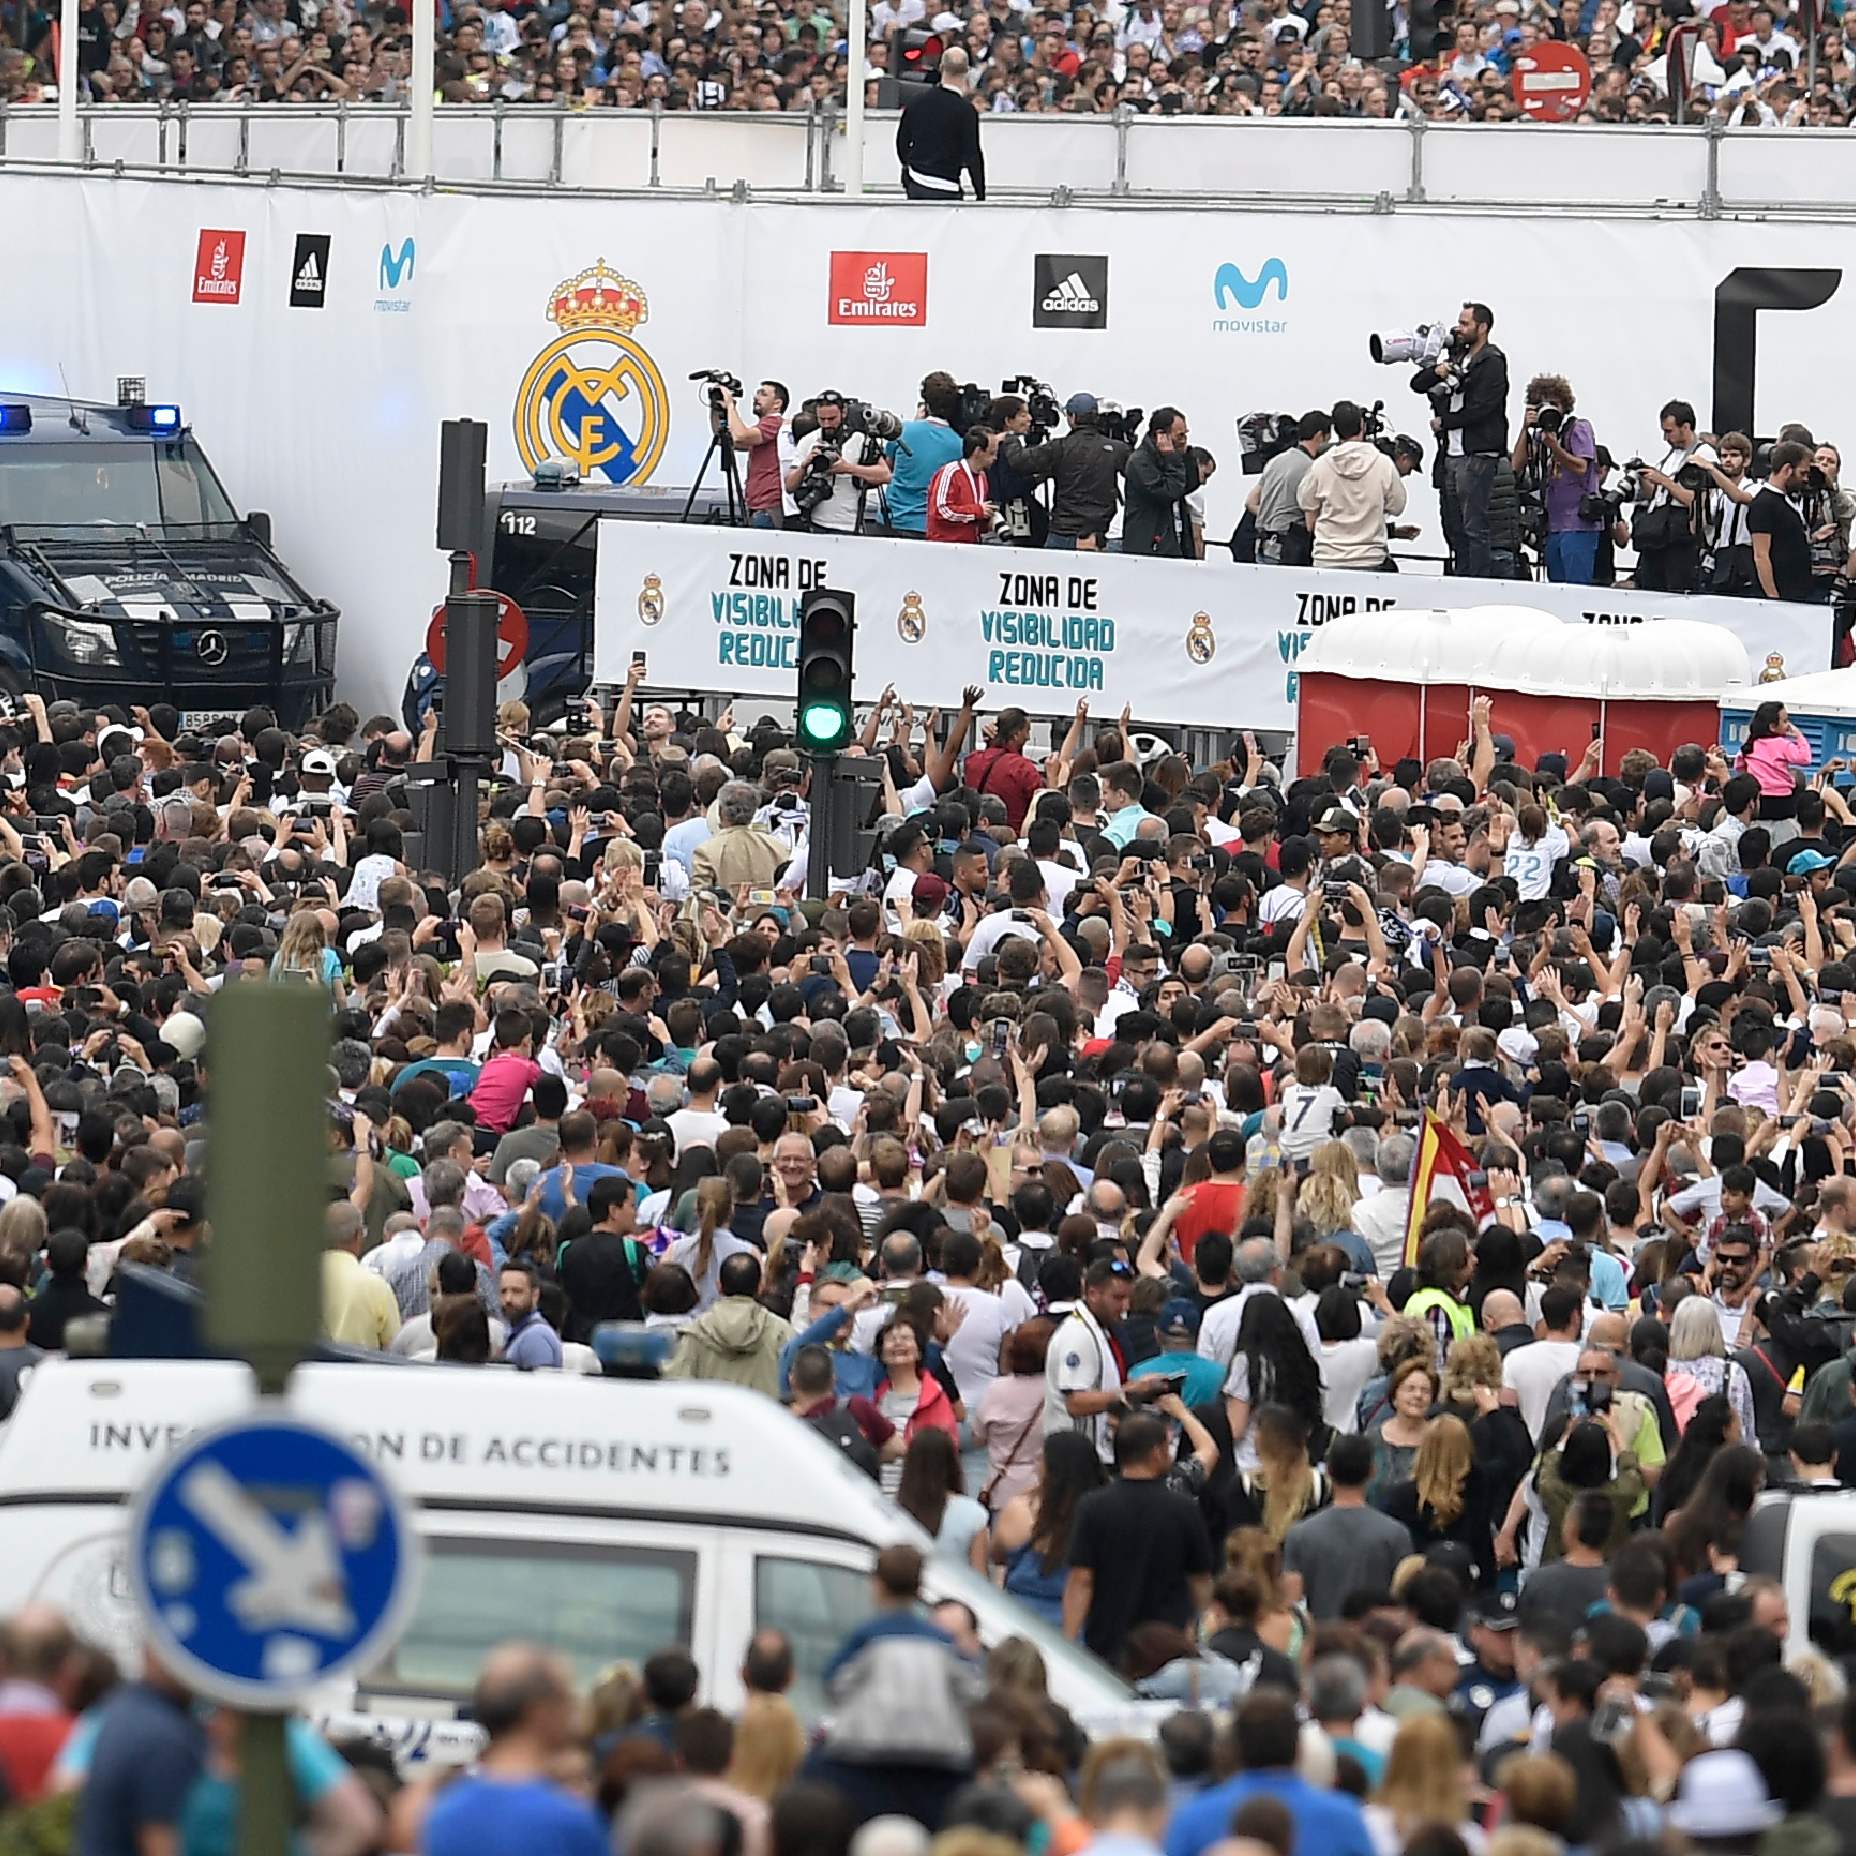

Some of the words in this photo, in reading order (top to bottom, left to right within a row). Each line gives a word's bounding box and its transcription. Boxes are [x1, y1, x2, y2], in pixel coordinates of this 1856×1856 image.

[838, 298, 917, 319] Emirates
[1041, 297, 1099, 313] adidas
[1212, 319, 1288, 334] movistar
[506, 515, 536, 535] 112
[729, 553, 790, 589] ZONA
[797, 557, 829, 591] DE
[711, 591, 802, 630] VISIBILI
[999, 571, 1059, 608] ZONA
[1067, 576, 1098, 612] DE
[718, 630, 800, 670] REDUC
[981, 610, 1115, 653] VISIBILIDAD
[987, 649, 1105, 692] REDUCIDA
[1507, 854, 1541, 881] 22
[1293, 1096, 1317, 1133] 7
[419, 1432, 469, 1463] DE
[484, 1437, 733, 1476] ACCIDENTES
